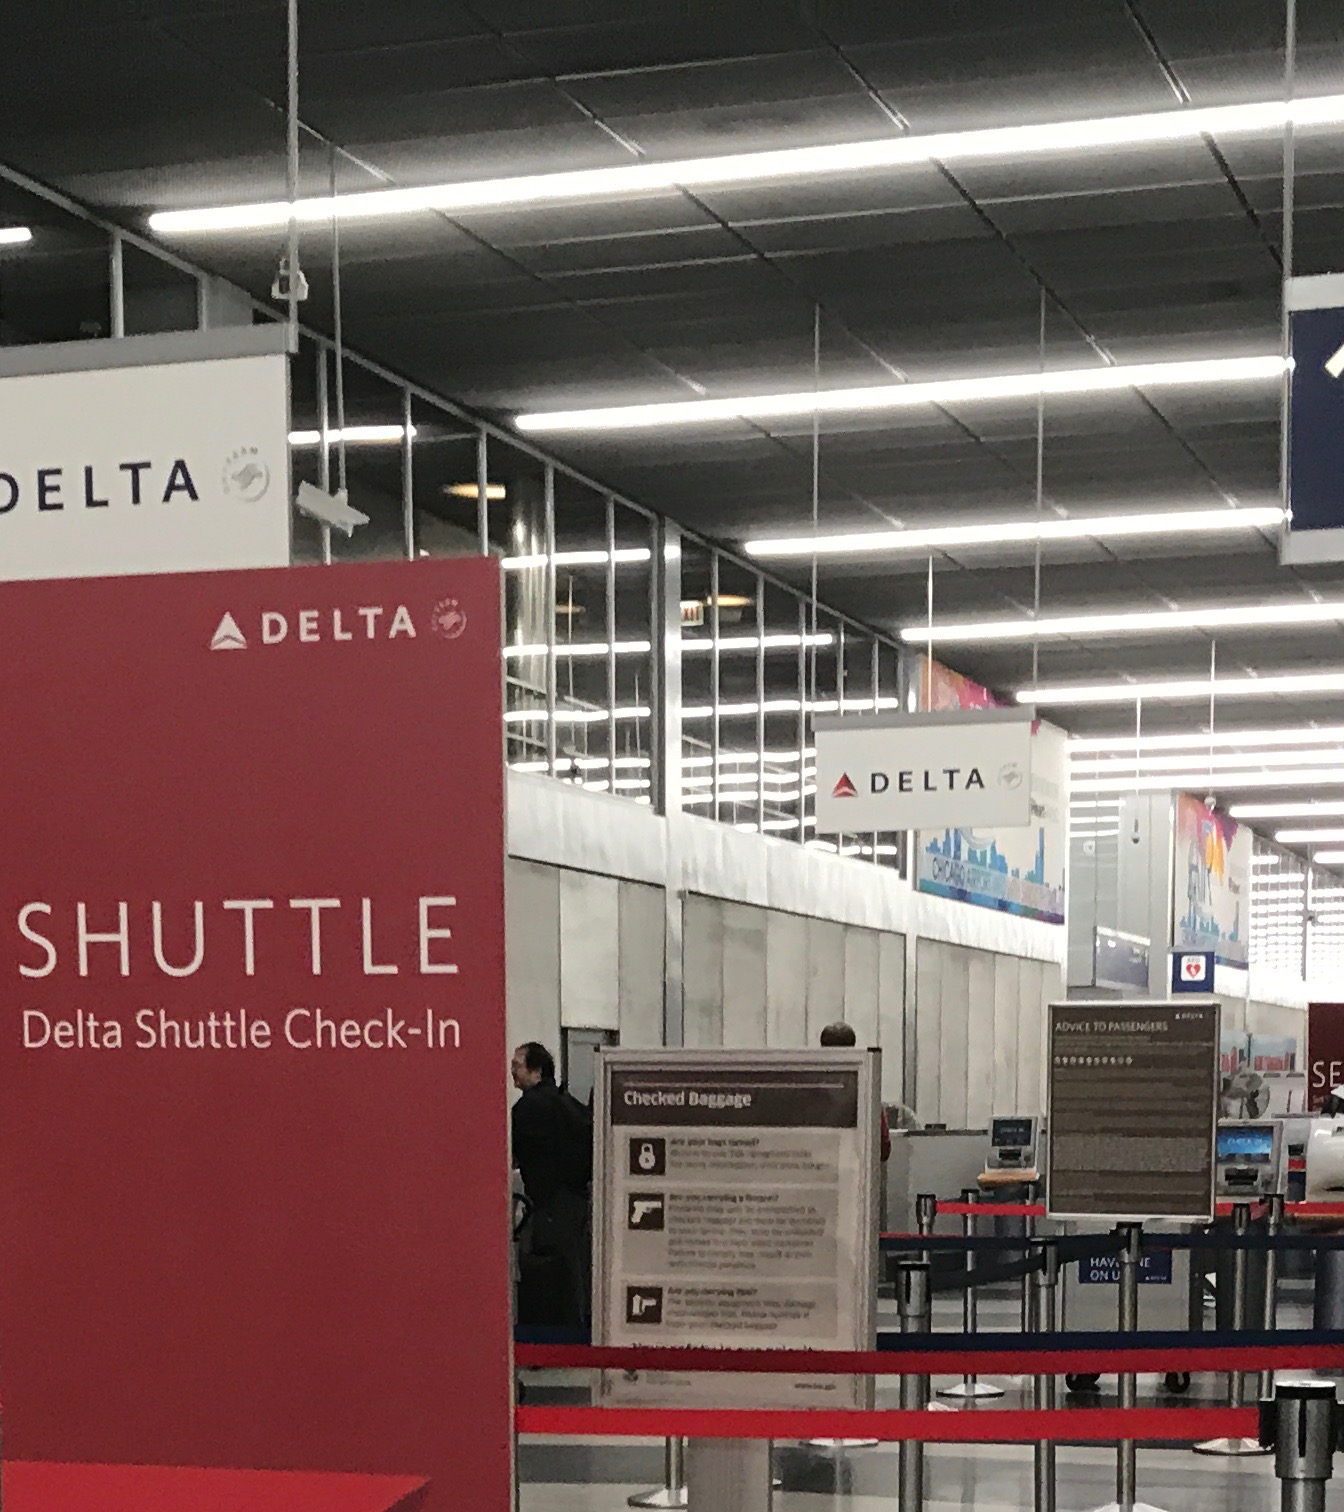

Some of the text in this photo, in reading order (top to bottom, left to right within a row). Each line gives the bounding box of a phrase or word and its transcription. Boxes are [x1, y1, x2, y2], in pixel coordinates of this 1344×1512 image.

[261, 604, 417, 644] DELTA
[870, 767, 986, 794] DELTA
[17, 896, 459, 978] SHUTTLE
[22, 1007, 461, 1049] Delta Shuttle Check-In
[1055, 1020, 1169, 1032] ADVICE TO PASSENGERS
[623, 1090, 752, 1109] Checked Baggage
